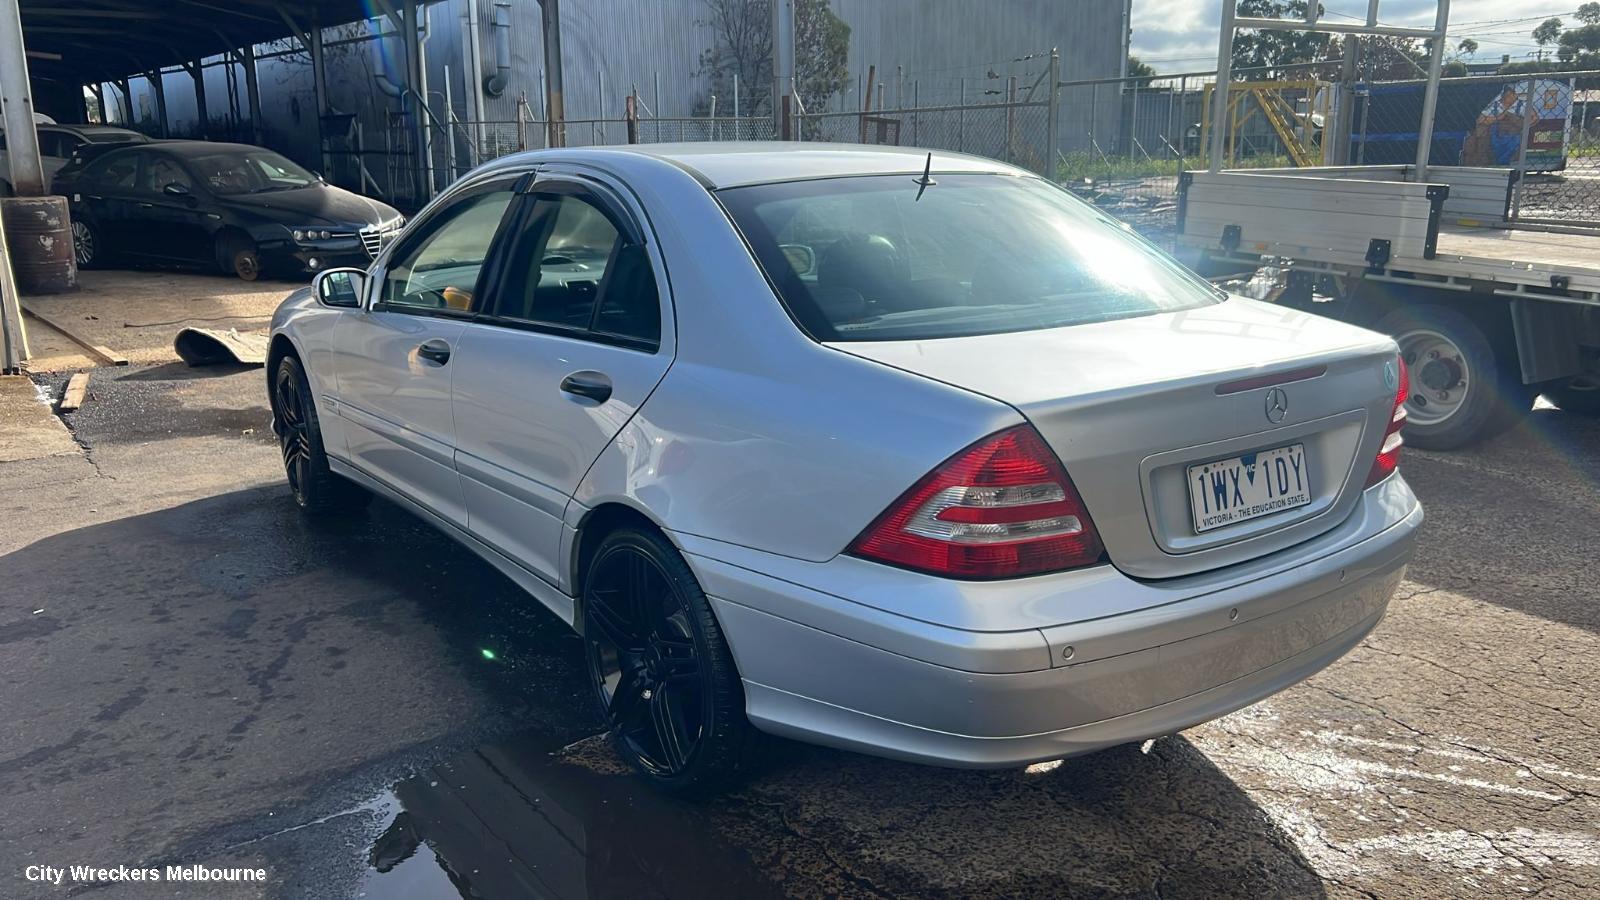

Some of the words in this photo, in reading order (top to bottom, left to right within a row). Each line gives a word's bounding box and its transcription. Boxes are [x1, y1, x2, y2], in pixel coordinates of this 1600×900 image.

[1198, 466, 1244, 514] 1WX
[1262, 453, 1302, 498] 1DY
[1202, 513, 1233, 527] VICTORIA
[1238, 505, 1251, 518] THE
[1251, 499, 1287, 515] EDUCATION
[1287, 494, 1305, 506] STATE
